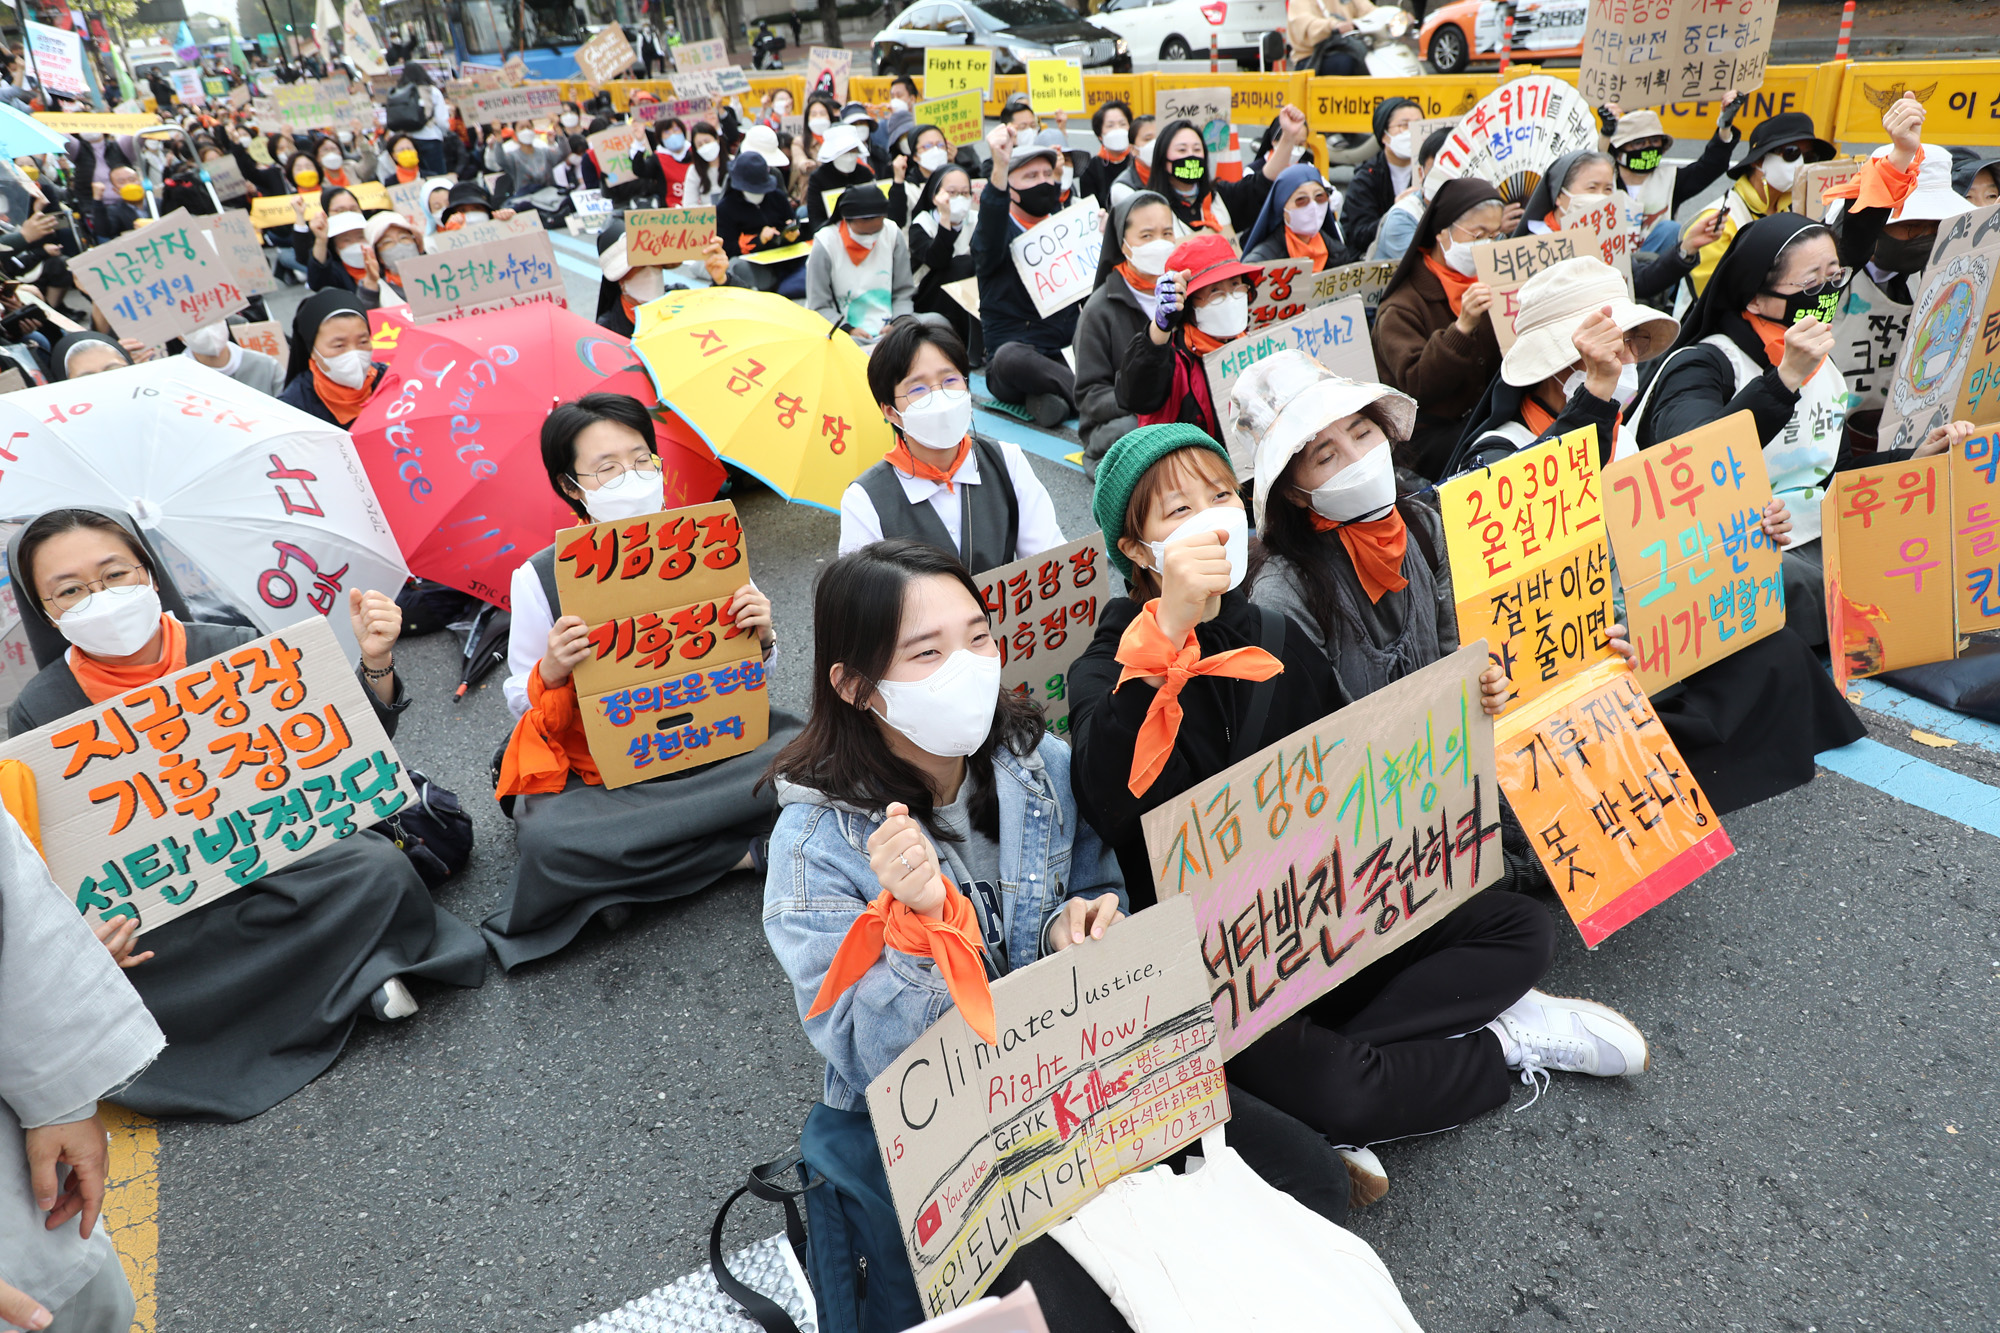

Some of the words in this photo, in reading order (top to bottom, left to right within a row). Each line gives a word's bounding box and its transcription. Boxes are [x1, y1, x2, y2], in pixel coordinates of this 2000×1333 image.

[929, 57, 962, 72] Fight
[967, 58, 988, 71] For
[948, 78, 968, 90] 1.5
[1032, 87, 1057, 100] Fossil
[1059, 87, 1082, 99] Fuels
[1042, 73, 1055, 85] No
[1057, 73, 1069, 84] To
[1586, 67, 1627, 104] 신공항
[1635, 68, 1671, 96] 계획
[1164, 98, 1201, 120] Save
[1204, 103, 1219, 116] The
[1439, 84, 1552, 168] 기후위기
[630, 213, 679, 227] Climate
[631, 228, 677, 257] Right
[1023, 223, 1069, 268] COP
[1075, 210, 1100, 239] 26
[112, 273, 195, 321] 기후정의
[414, 259, 498, 302] 지금당장
[498, 252, 554, 291] 기후정의
[1034, 249, 1080, 301] ACT
[1076, 241, 1103, 277] NO
[690, 329, 853, 455] 지금당장
[1466, 437, 1595, 530] 2030년
[557, 512, 744, 585] 지금당장
[1482, 477, 1602, 578] 온실가스
[467, 579, 498, 600] JPIC
[1490, 568, 1554, 640] 절반
[1559, 542, 1608, 602] 이상
[1639, 520, 1716, 609] 그만
[1533, 600, 1610, 683] 줄이면
[1637, 599, 1710, 679] 내가
[1708, 562, 1786, 642] 변할게
[50, 637, 307, 780] 지금당장
[599, 671, 711, 729] 정의로운
[707, 659, 768, 697] 전환
[88, 702, 353, 836] 기후정의
[625, 714, 746, 770] 실천하자
[1336, 677, 1473, 848] 기후정의
[1514, 680, 1656, 793] 기후재난
[1349, 774, 1502, 937] 중단하라
[1538, 819, 1597, 894] 못
[1591, 751, 1709, 851] 막는다!
[899, 1007, 1054, 1131] Climate
[1060, 965, 1164, 1018] Justice,
[987, 1052, 1070, 1115] Right
[1079, 995, 1152, 1058] Now!
[1134, 1044, 1166, 1074] 병든
[1129, 1072, 1172, 1108] 우리의
[941, 1159, 990, 1214] Youtube
